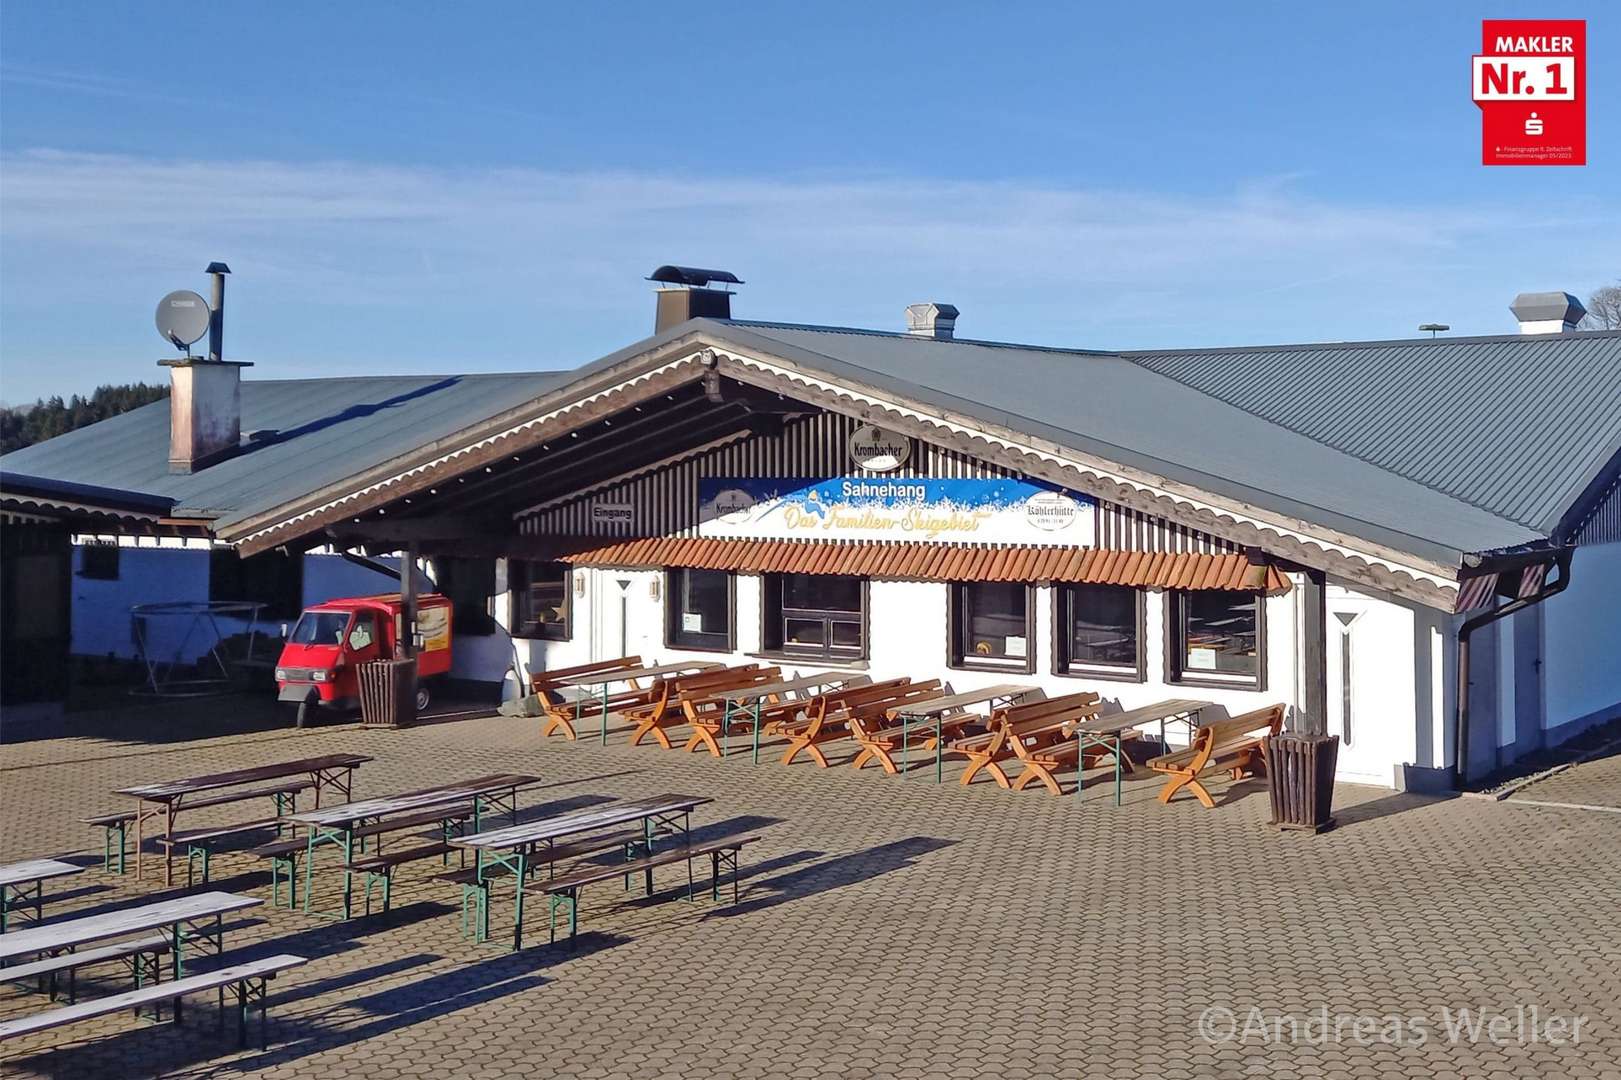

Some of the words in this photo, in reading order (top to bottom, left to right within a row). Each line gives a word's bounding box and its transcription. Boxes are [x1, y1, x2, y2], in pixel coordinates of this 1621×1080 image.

[854, 442, 902, 457] Krombacher
[842, 481, 926, 500] Sahnehang
[593, 507, 633, 519] Eingang
[784, 506, 819, 530] Das
